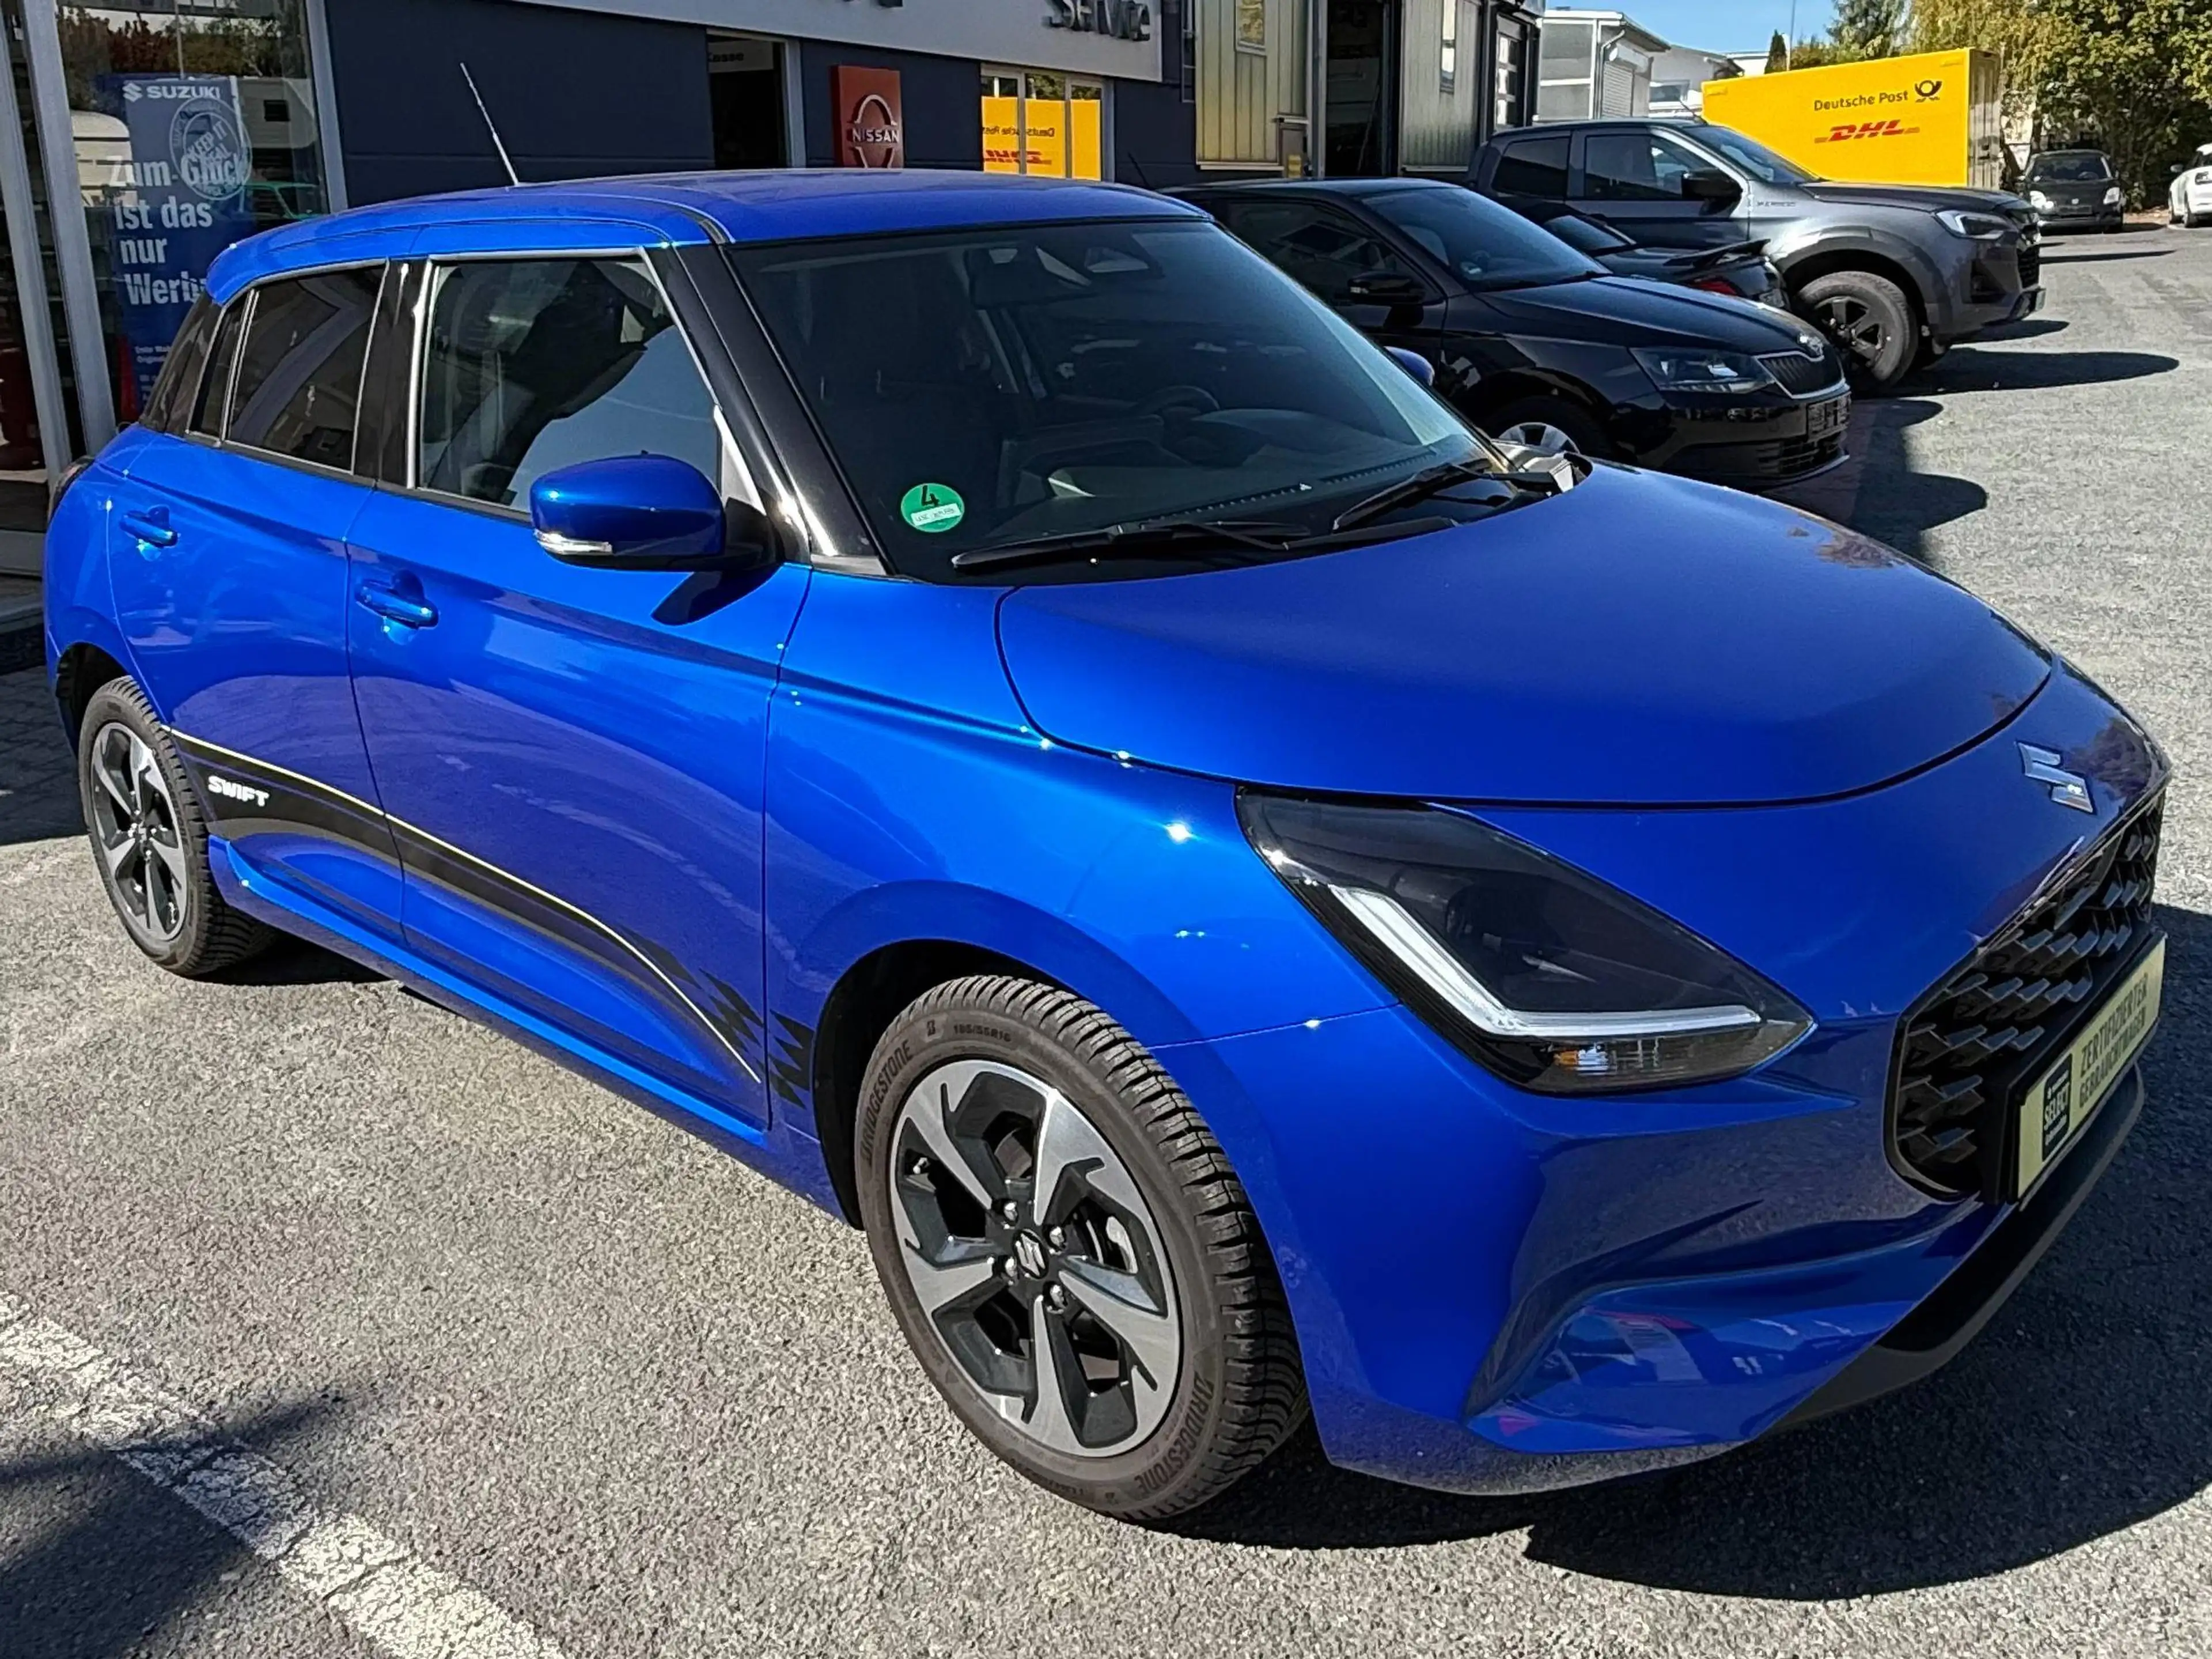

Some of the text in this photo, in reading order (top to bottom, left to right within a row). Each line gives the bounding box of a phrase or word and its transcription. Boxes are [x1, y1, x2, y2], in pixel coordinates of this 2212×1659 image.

[146, 85, 221, 99] SUZUKI
[1814, 90, 1909, 111] Deutsche Post
[852, 128, 900, 142] NISSAN
[1828, 119, 1904, 142] DHL
[161, 195, 213, 229] das
[120, 238, 168, 264] nur
[124, 271, 206, 305] Werb
[922, 485, 940, 507] 4
[208, 775, 270, 807] SWIFT
[861, 1039, 914, 1167] BRIDGESTONE
[1135, 1370, 1214, 1495] BRIDGESTONE
